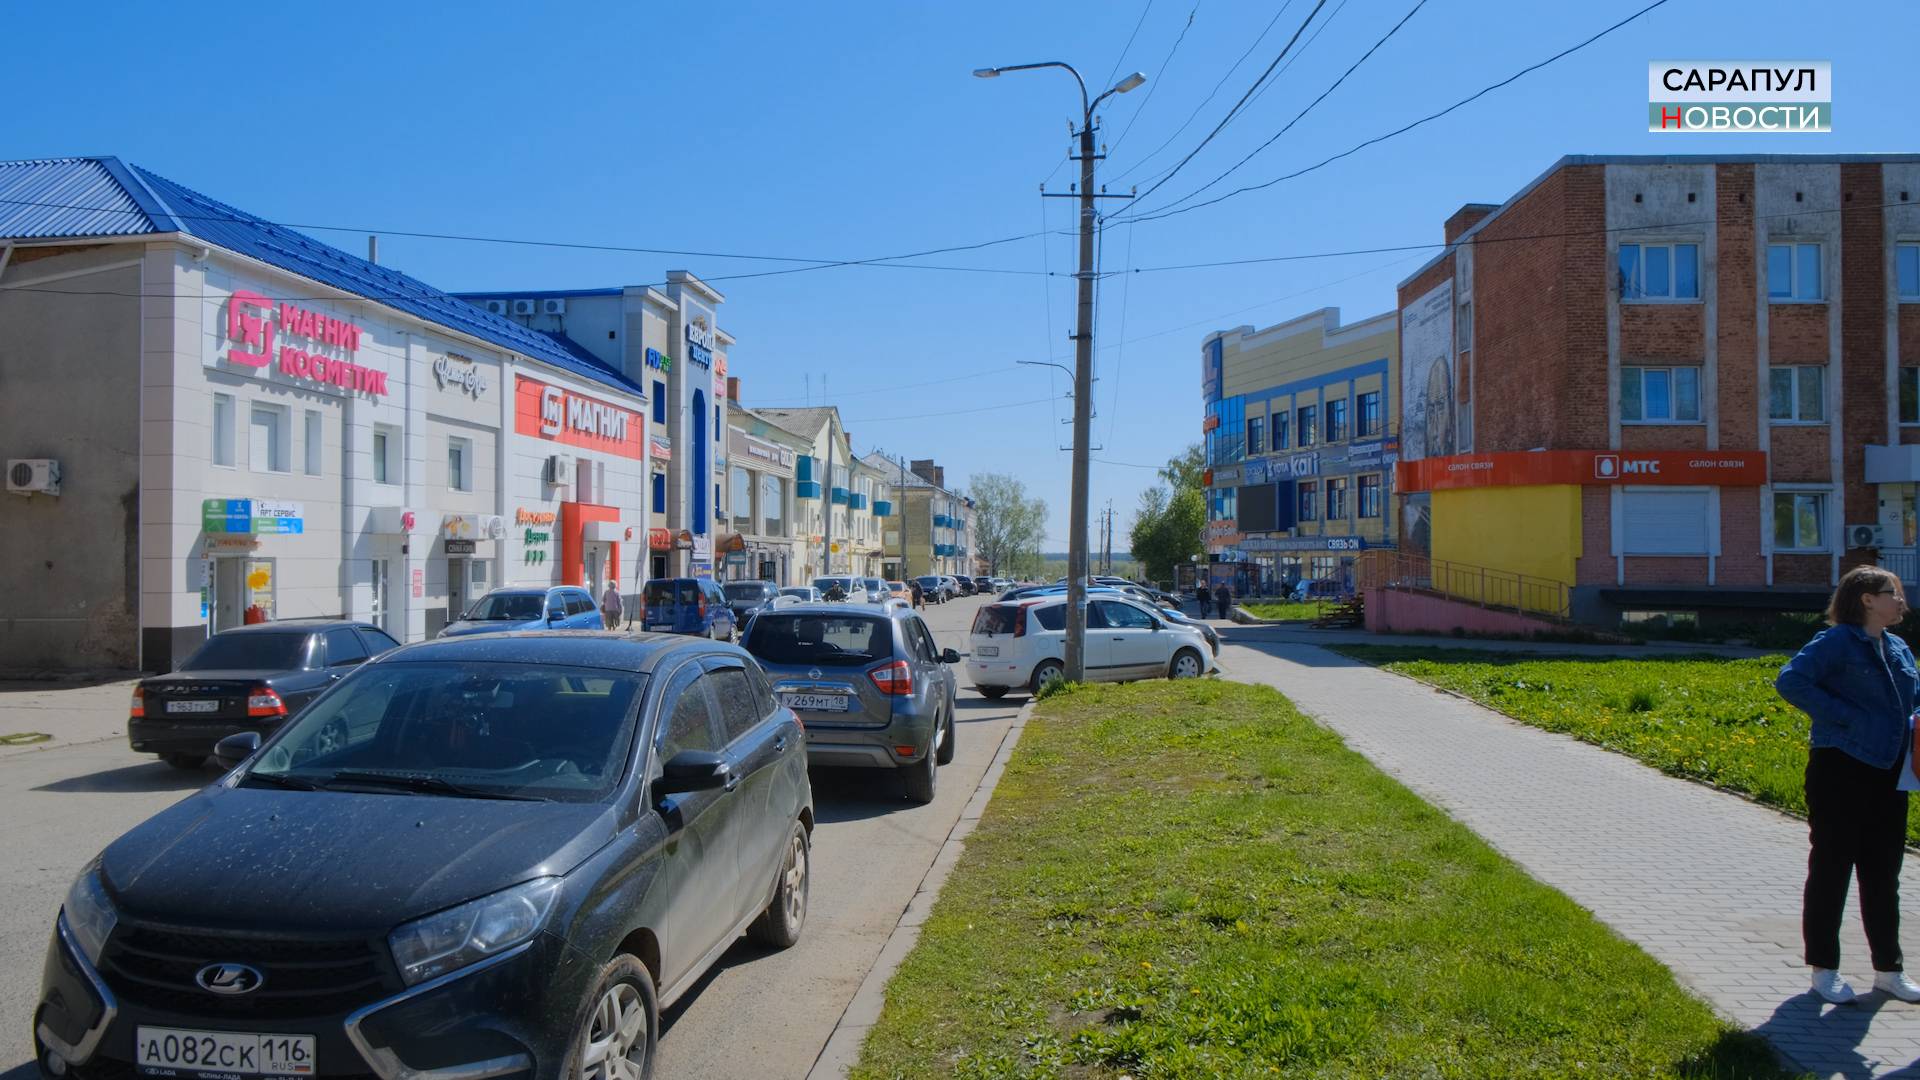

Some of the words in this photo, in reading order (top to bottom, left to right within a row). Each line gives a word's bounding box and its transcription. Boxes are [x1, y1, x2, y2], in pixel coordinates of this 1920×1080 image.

[278, 301, 366, 353] МАГНИТ
[278, 344, 389, 397] КОСМЕТИК
[565, 394, 631, 442] МАГНИТ
[1290, 451, 1320, 477] kari
[1622, 459, 1662, 474] МТС
[1688, 458, 1717, 469] салон
[1718, 458, 1745, 469] связи
[1327, 538, 1348, 550] СВЯЗЬ
[786, 695, 831, 707] У269МТ
[145, 1033, 256, 1069] А082СК
[261, 1038, 306, 1063] 116
[159, 1068, 177, 1077] LADA
[271, 1061, 295, 1071] RUS
